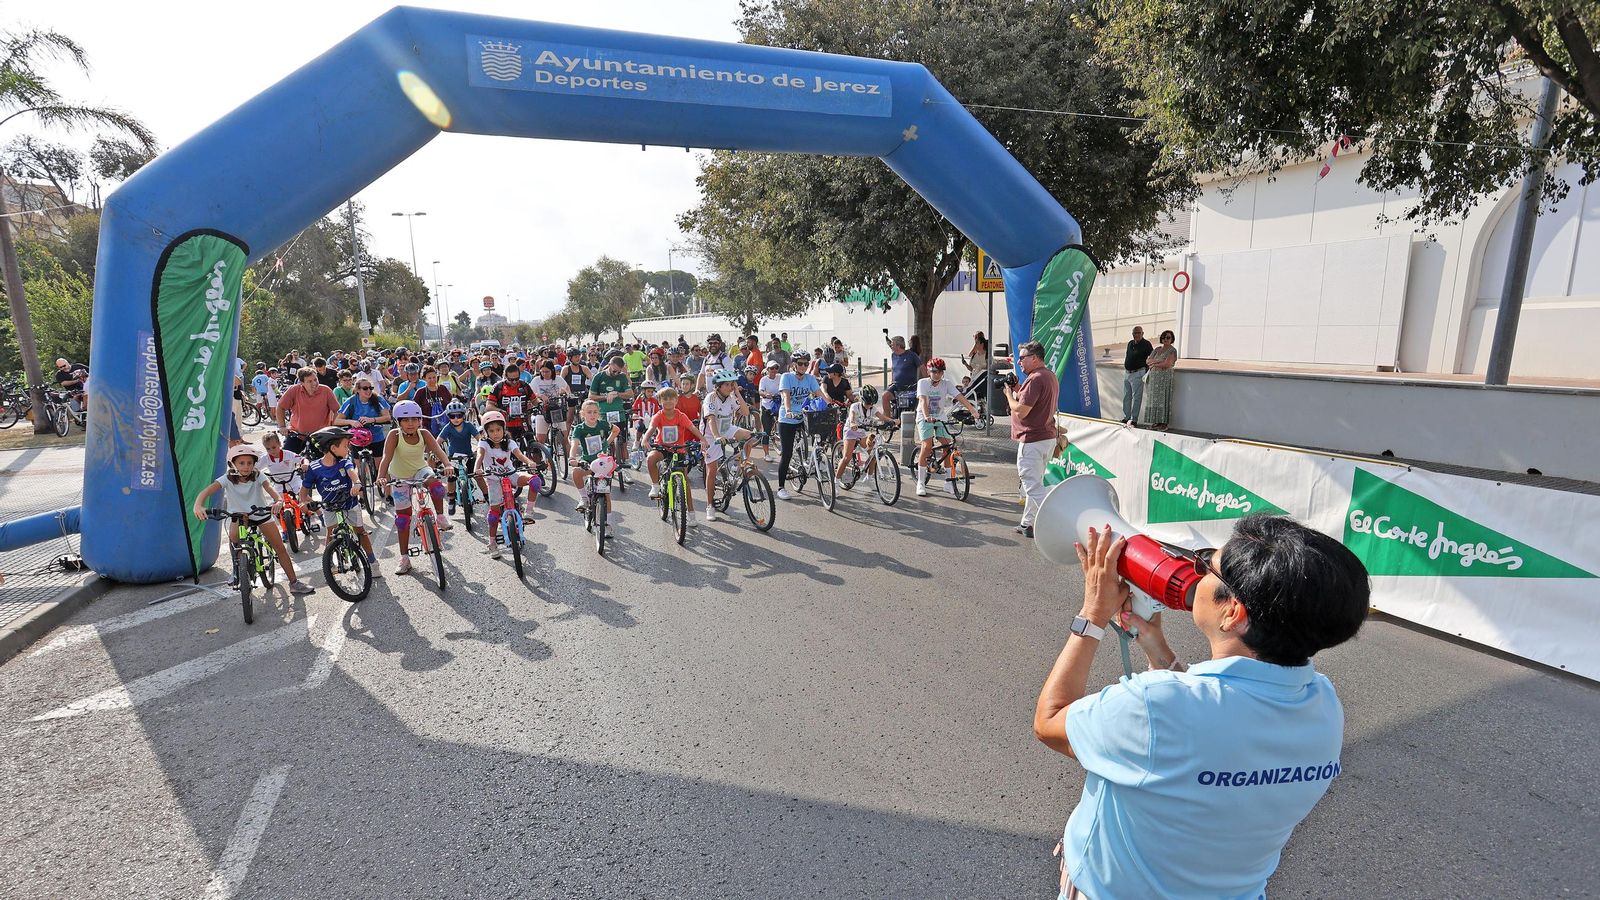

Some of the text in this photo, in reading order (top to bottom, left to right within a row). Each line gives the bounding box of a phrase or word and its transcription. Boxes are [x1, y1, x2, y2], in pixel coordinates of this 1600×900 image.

[534, 49, 881, 95] Ayuntamiento de Jerez
[534, 69, 648, 92] Deportes
[189, 260, 231, 343] Inglés
[981, 281, 1004, 289] PEATONE
[1050, 270, 1084, 334] Inglés
[1151, 472, 1252, 513] El Corte Inglés
[1350, 509, 1523, 571] El Corte Inglés
[1197, 761, 1341, 787] ORGANIZACIÓN
